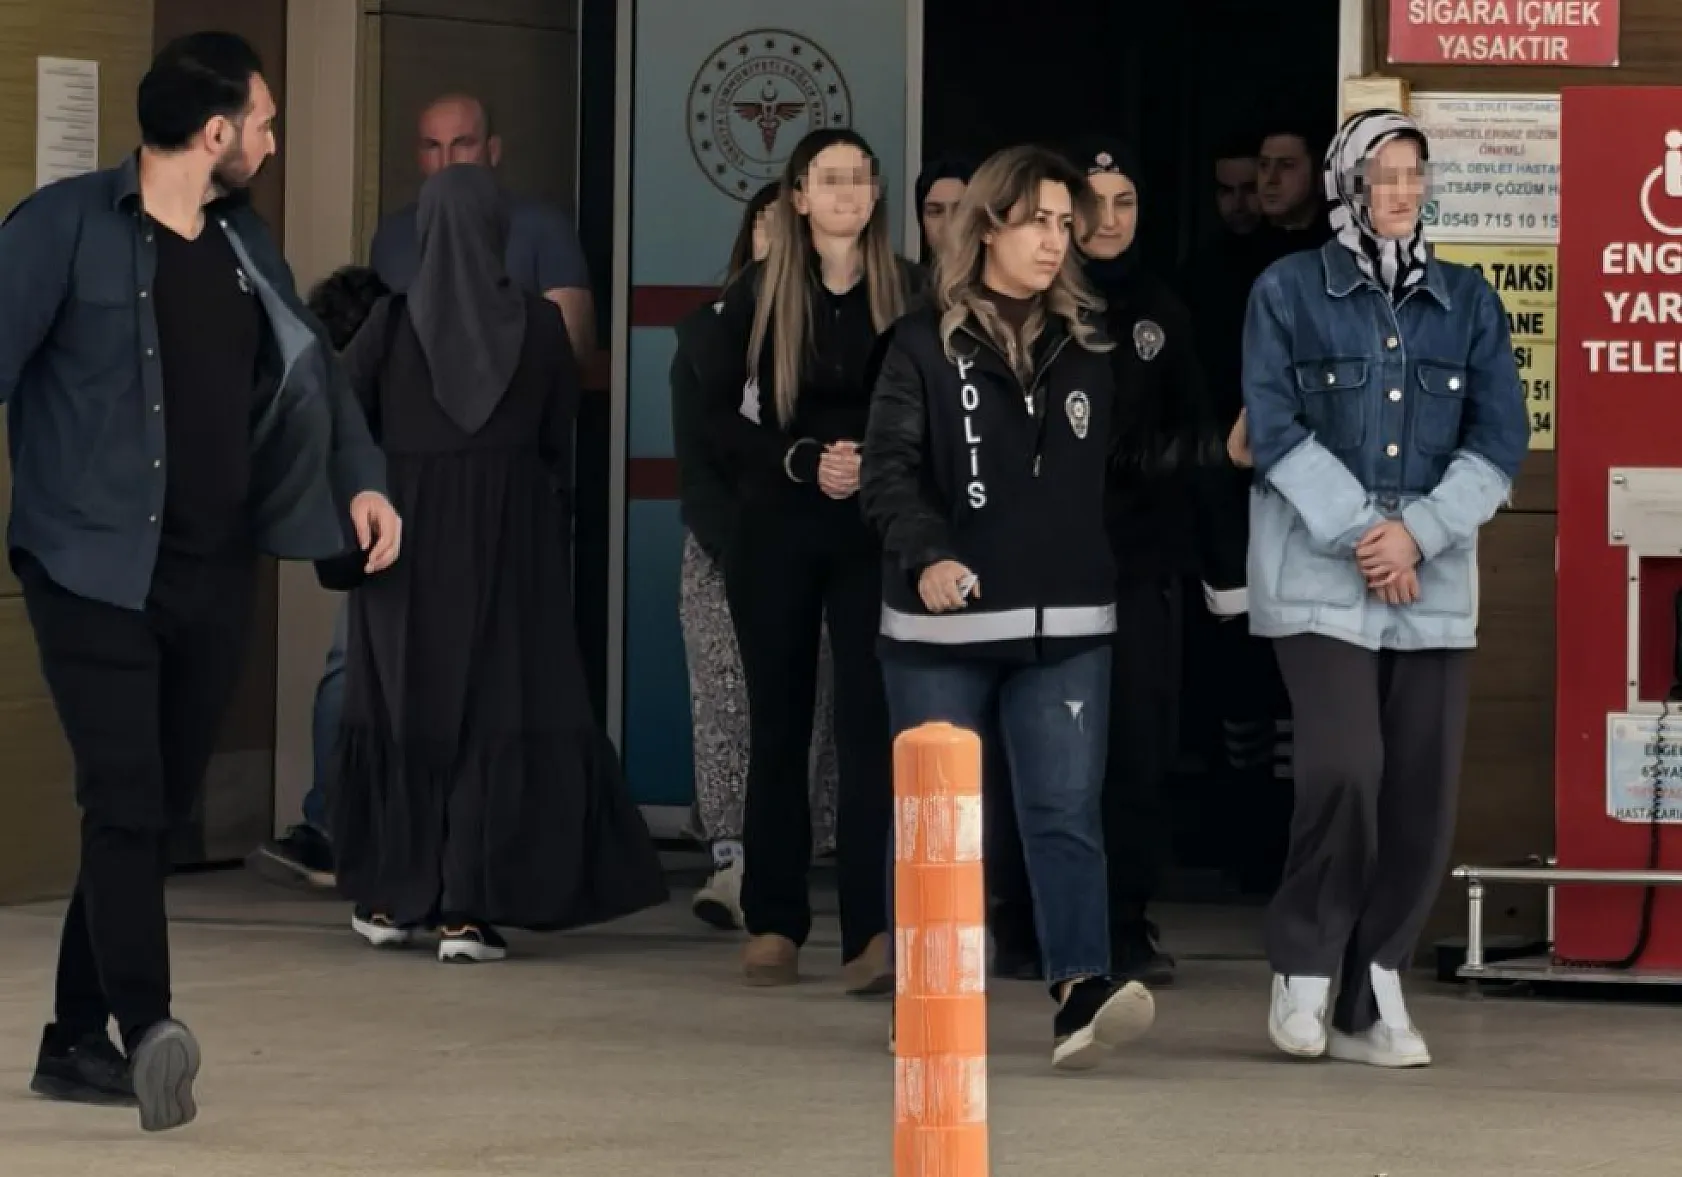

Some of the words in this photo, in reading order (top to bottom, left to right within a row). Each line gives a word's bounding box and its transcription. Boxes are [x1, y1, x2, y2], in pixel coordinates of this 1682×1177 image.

[1437, 35, 1569, 61] YASAKTIR
[1466, 162, 1513, 175] DEVLET
[1436, 181, 1492, 194] TSAPP
[1495, 180, 1544, 198] ÇÖZÜM
[1441, 211, 1479, 227] 0549
[1483, 212, 1514, 229] 715
[1518, 213, 1537, 229] 10
[1603, 290, 1682, 324] YAR
[1504, 311, 1545, 335] ANE
[1582, 339, 1682, 374] TELE
